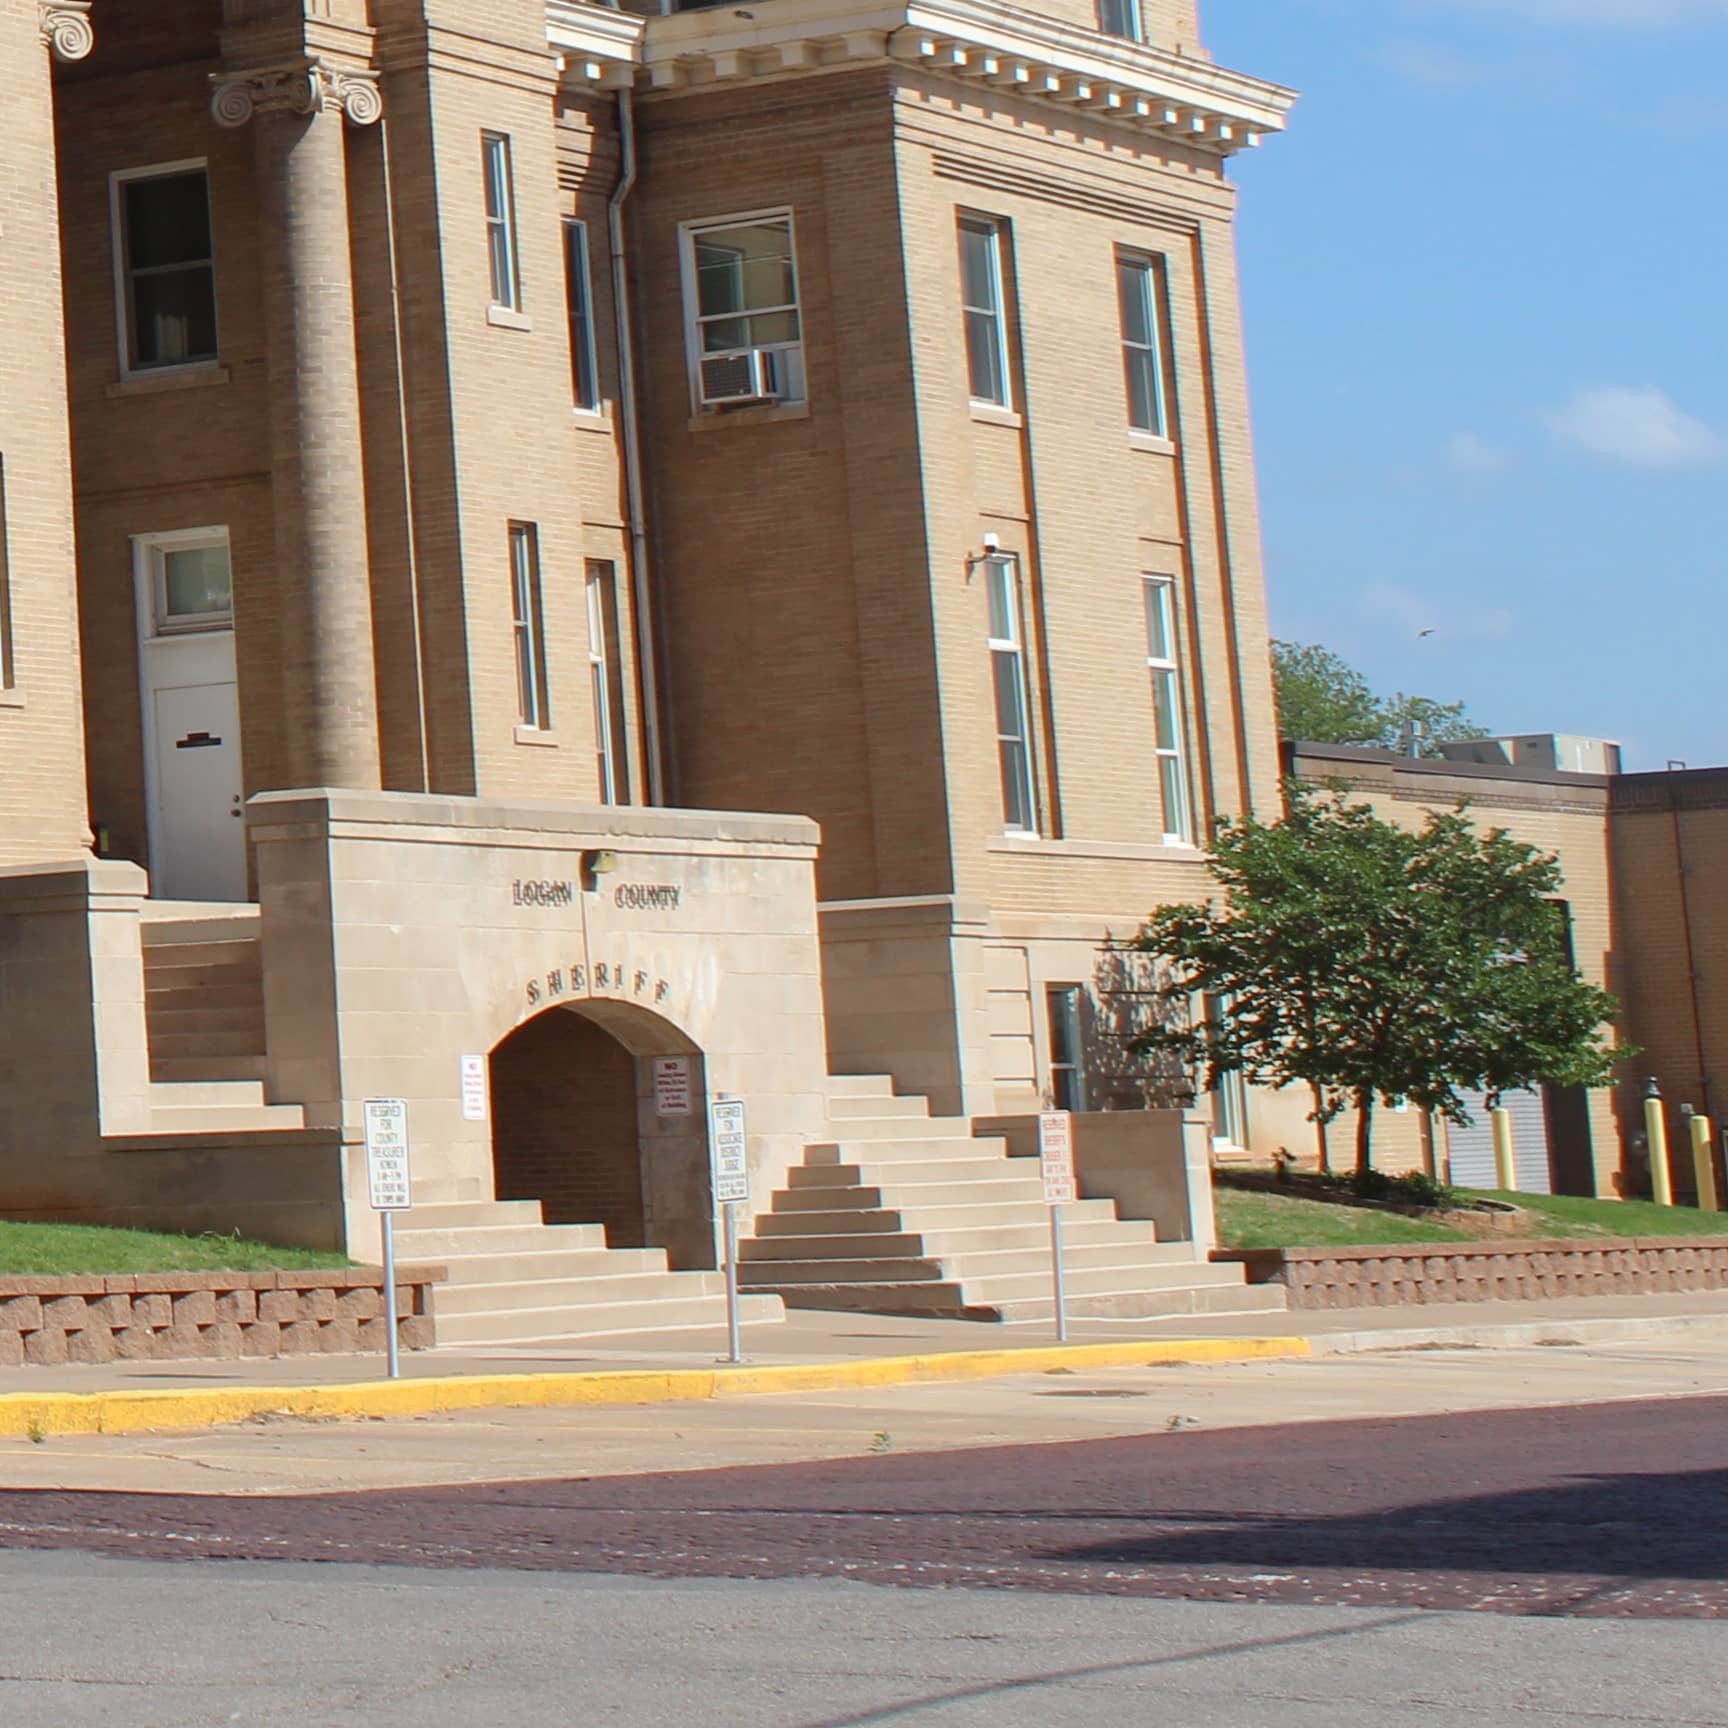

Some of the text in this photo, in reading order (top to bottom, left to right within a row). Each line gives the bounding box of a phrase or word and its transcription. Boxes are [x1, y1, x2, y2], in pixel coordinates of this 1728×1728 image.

[512, 878, 681, 910] LOGAN COUNTY
[526, 962, 669, 1005] SHERIFF
